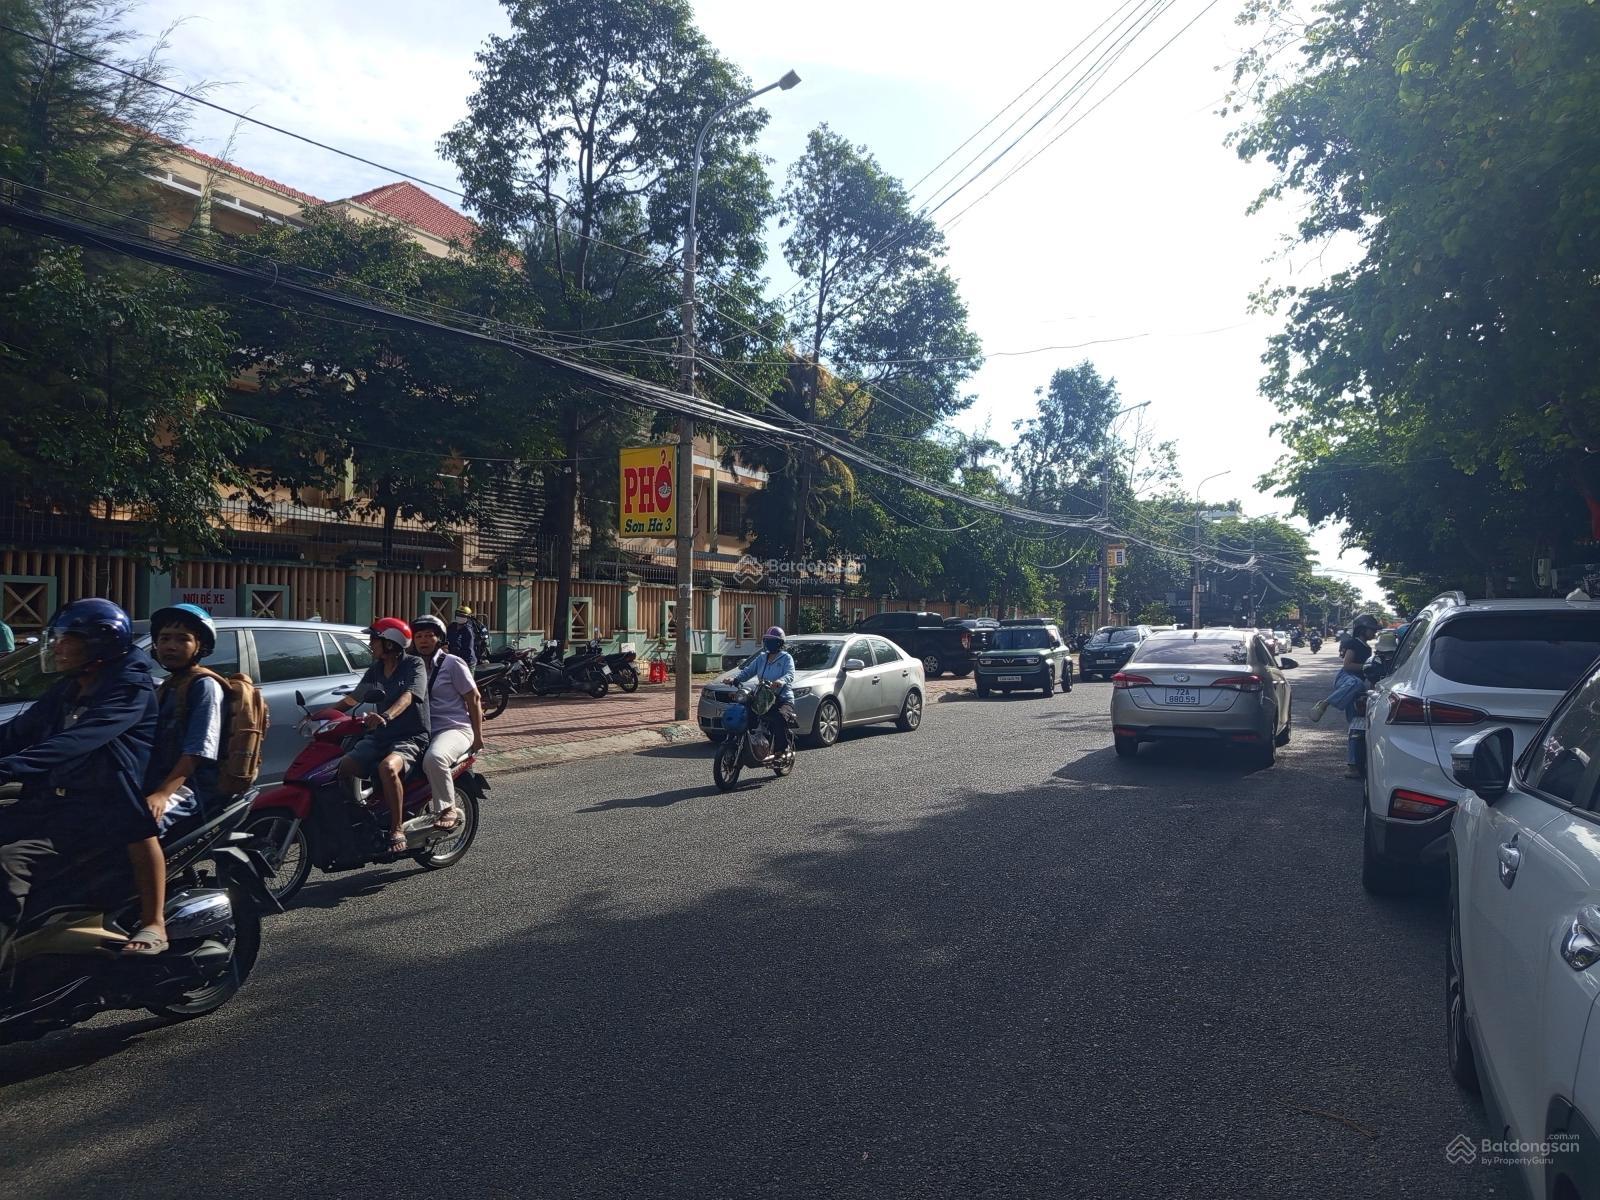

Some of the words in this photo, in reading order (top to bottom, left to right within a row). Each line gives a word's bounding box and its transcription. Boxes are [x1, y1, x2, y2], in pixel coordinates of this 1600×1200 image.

[624, 449, 673, 514] PHỞ
[624, 519, 645, 533] Sơn
[647, 518, 663, 532] Hà
[665, 518, 672, 532] 3
[213, 593, 225, 604] XE
[1176, 688, 1190, 696] 72A
[1168, 695, 1196, 703] 880.59
